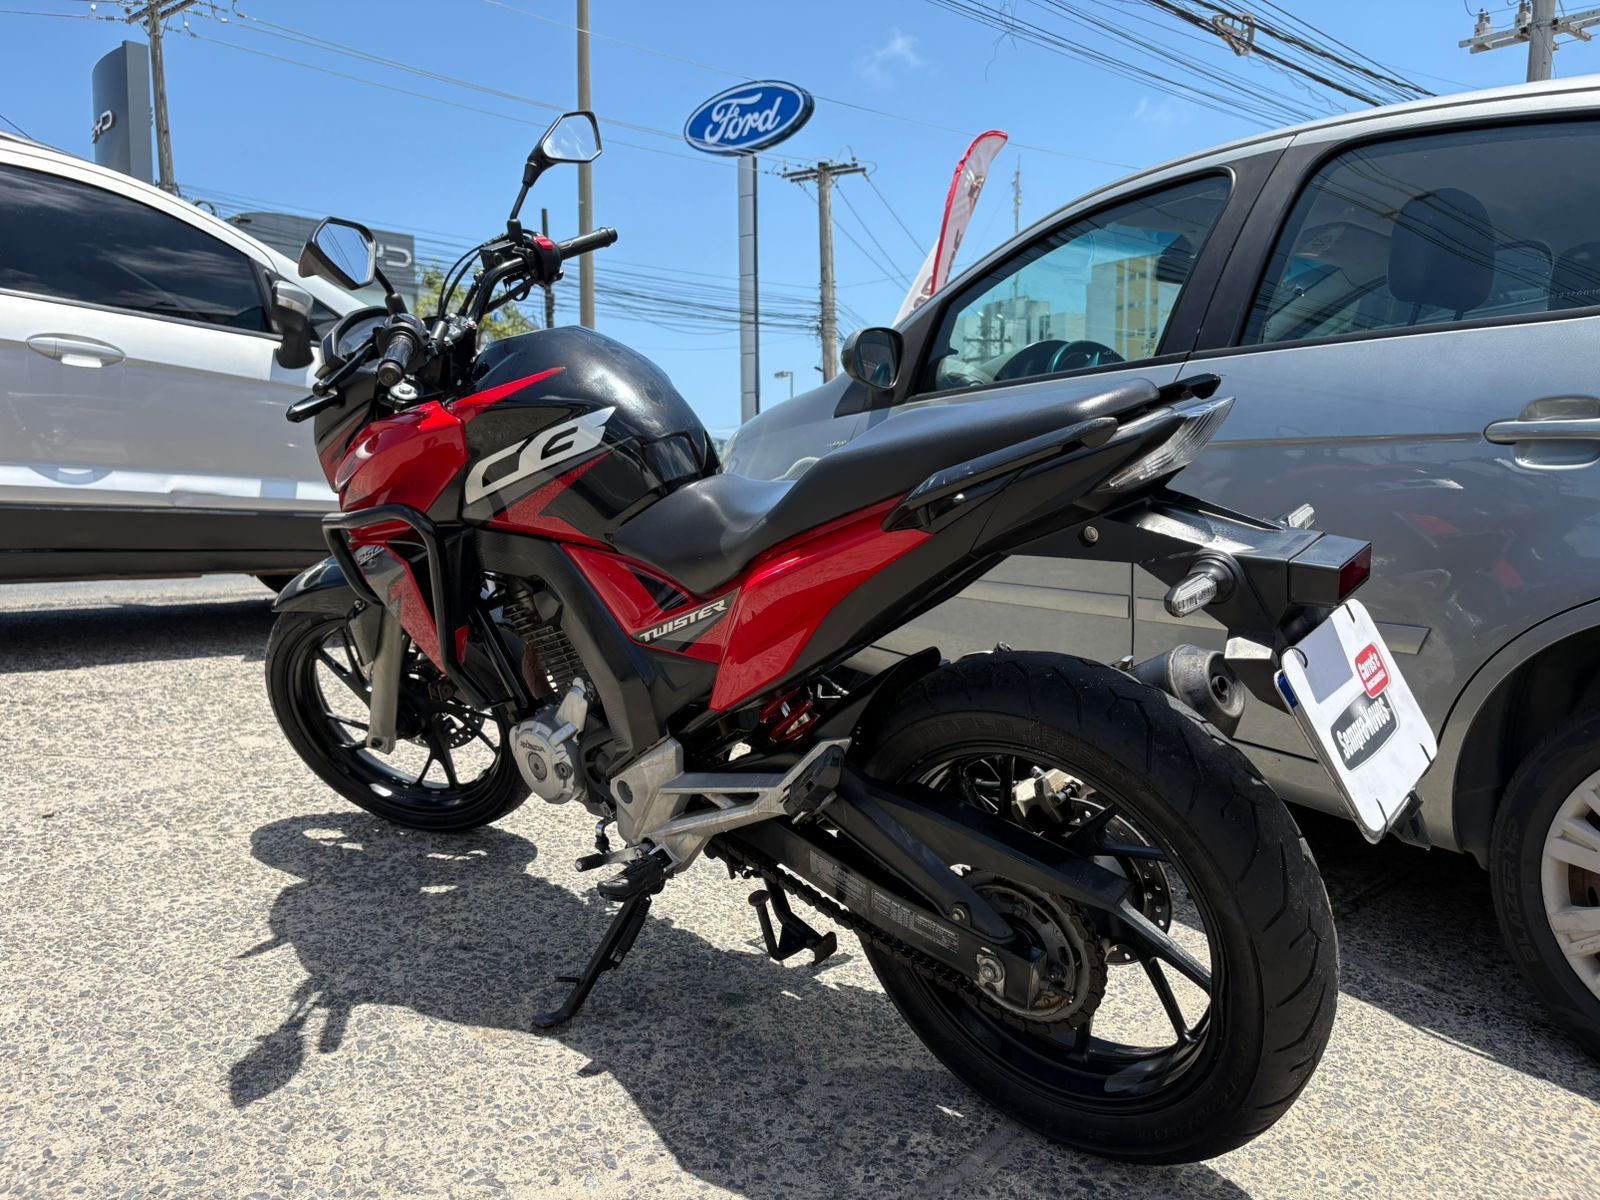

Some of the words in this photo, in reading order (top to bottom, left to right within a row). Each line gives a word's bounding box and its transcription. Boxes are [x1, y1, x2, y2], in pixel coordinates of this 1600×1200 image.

[704, 93, 782, 144] Ford
[465, 406, 616, 505] CB
[639, 599, 728, 642] TWISTER
[1502, 859, 1538, 963] BLAZER
